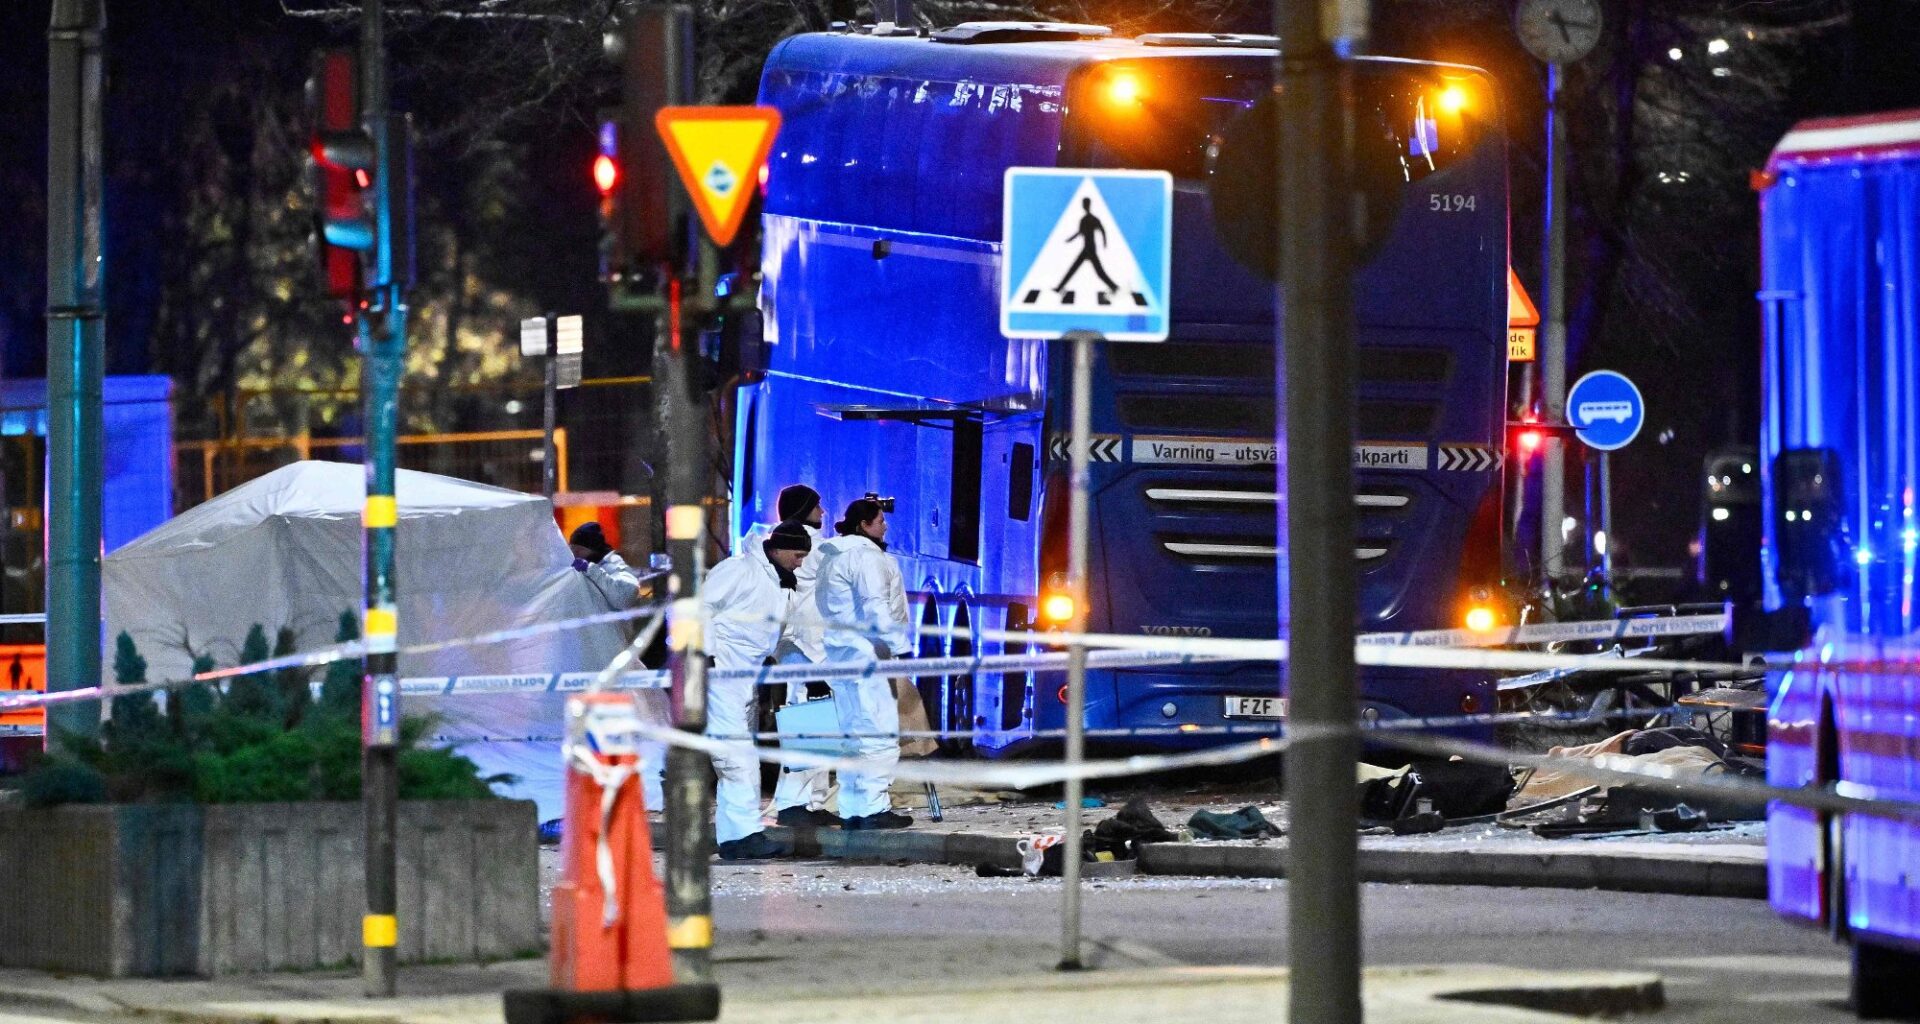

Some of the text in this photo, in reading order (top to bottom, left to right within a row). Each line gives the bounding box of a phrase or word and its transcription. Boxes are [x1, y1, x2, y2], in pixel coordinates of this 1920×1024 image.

[1430, 194, 1476, 212] 5194
[1152, 443, 1215, 462] Varning
[1140, 625, 1212, 638] VOLVO
[1240, 699, 1272, 714] FZF
